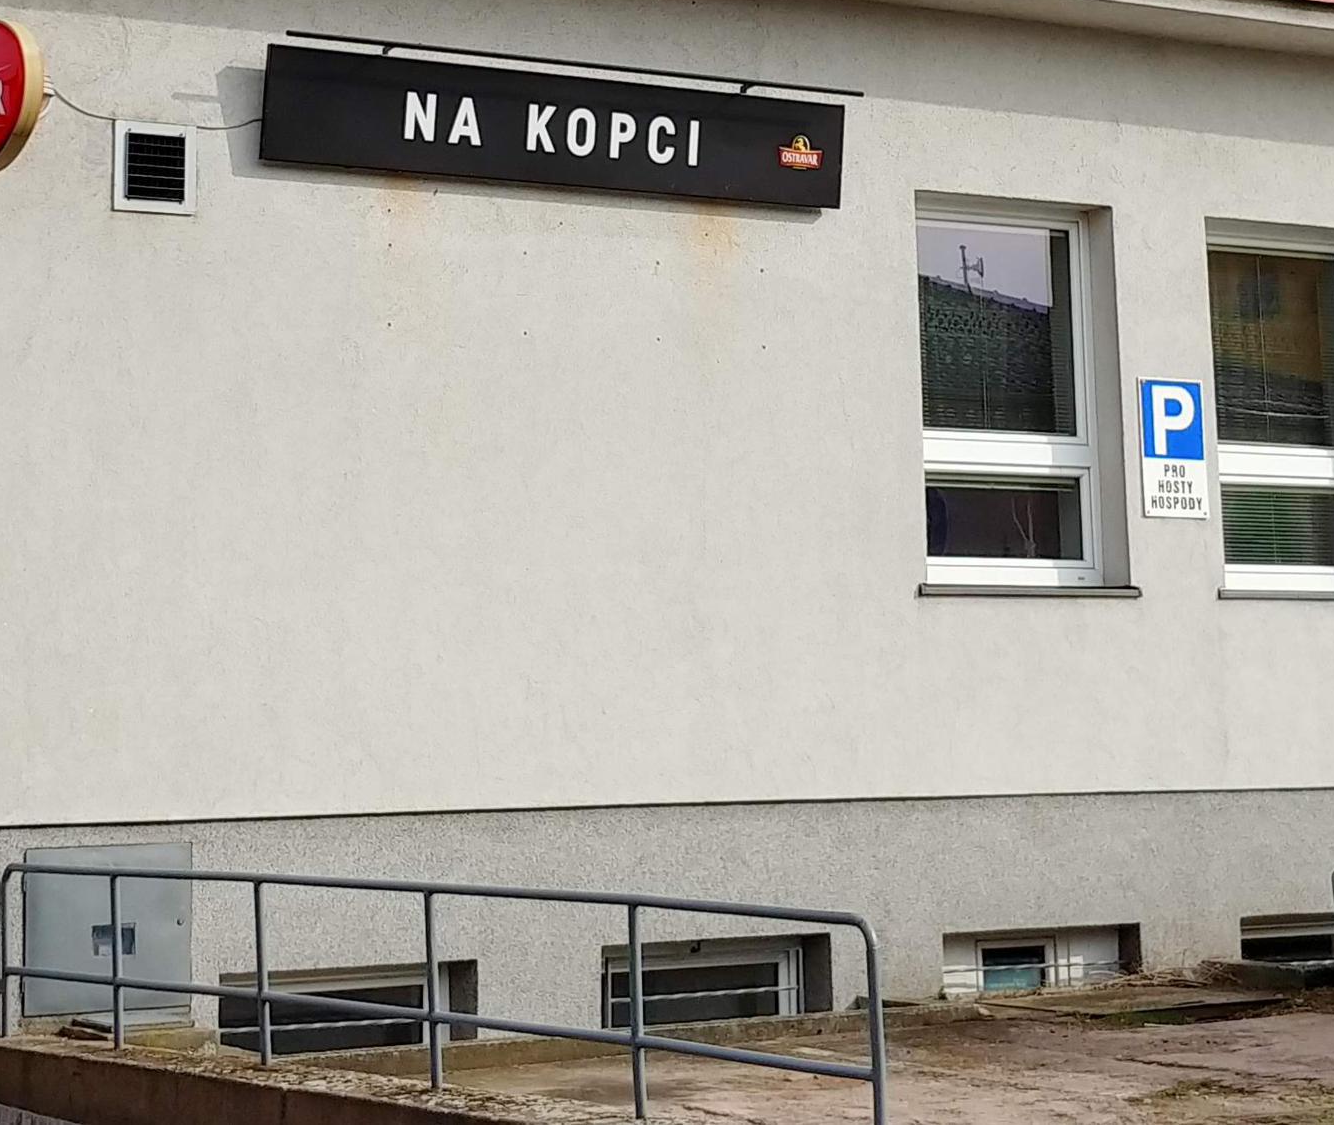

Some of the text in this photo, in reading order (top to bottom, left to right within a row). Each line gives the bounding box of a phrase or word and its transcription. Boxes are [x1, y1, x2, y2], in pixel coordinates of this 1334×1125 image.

[403, 91, 700, 167] NA KOPCI
[782, 151, 818, 166] OSTRAVAR
[1152, 385, 1195, 455] P
[1164, 464, 1186, 478] PRO
[1158, 480, 1193, 494] HOSTY
[1151, 495, 1202, 511] HOSPODY
